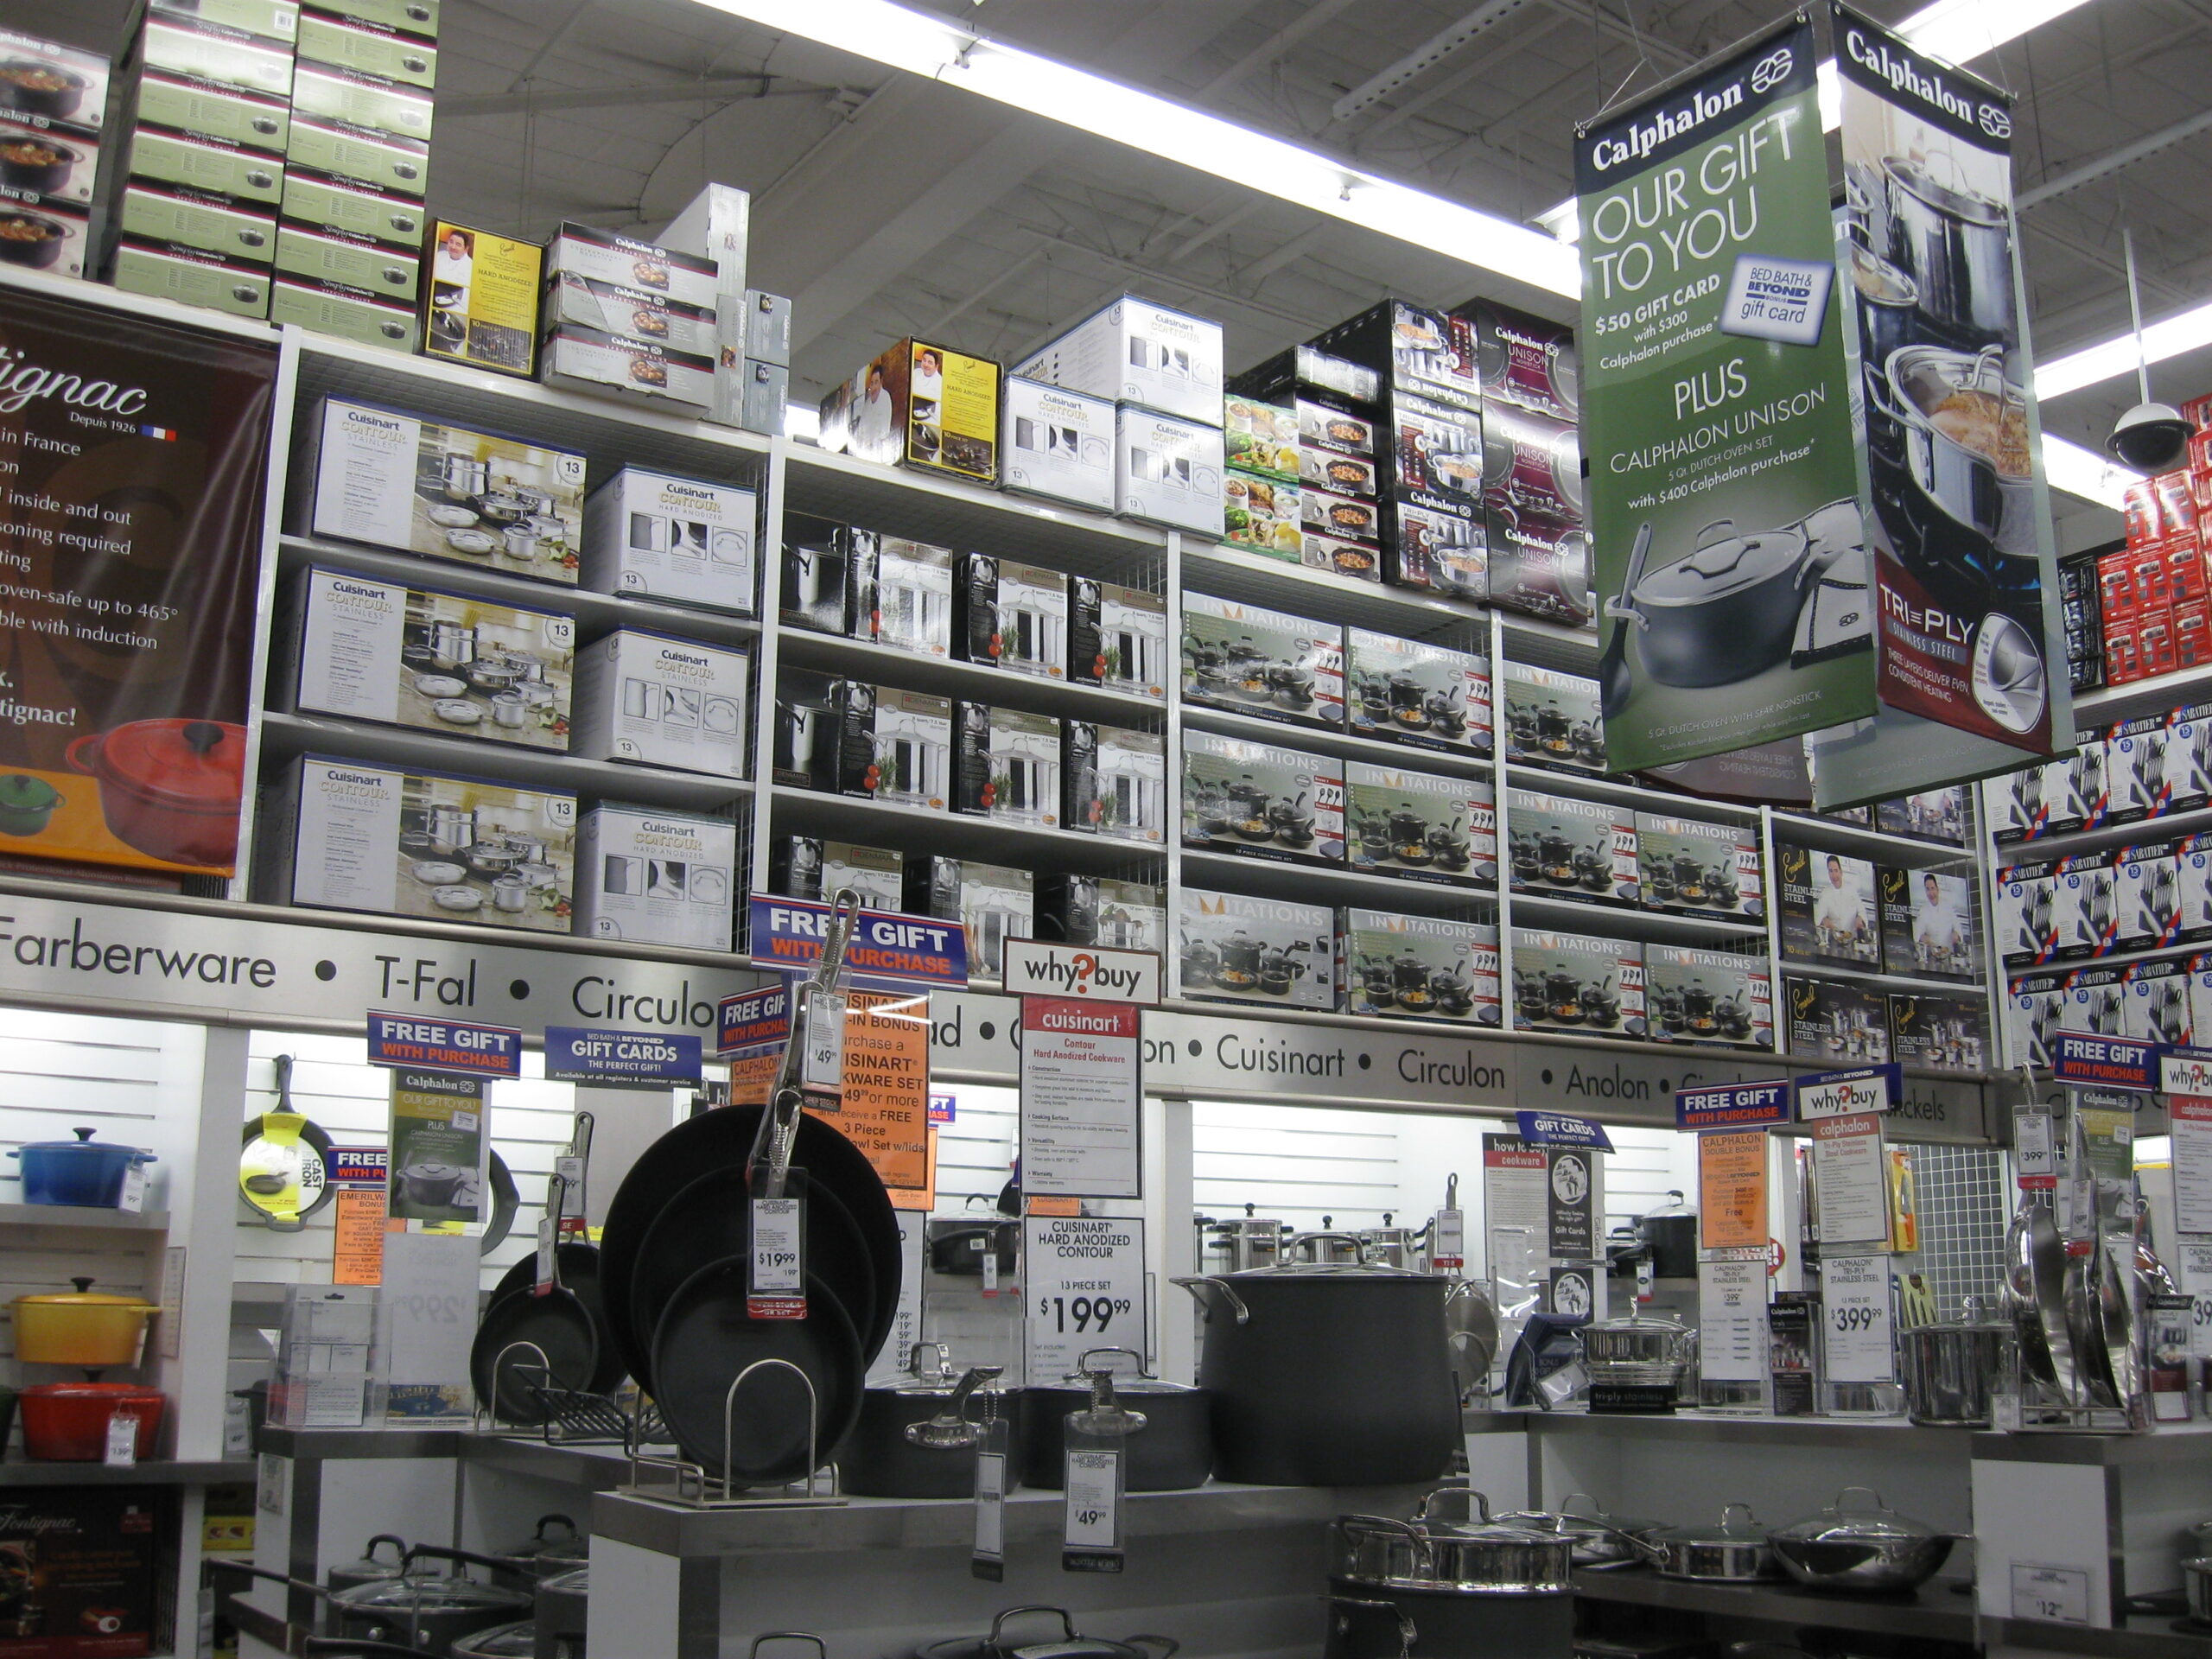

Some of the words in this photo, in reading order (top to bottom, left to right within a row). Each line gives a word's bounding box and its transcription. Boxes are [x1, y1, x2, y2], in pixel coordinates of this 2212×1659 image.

[1847, 31, 1974, 124] Calphalon
[1592, 84, 1742, 171] Calphalon
[1593, 168, 1689, 244] OUR
[1699, 109, 1797, 194] GIFT
[1593, 242, 1653, 299] TO
[1661, 186, 1758, 271] YOU
[1748, 281, 1810, 297] BEYOND
[1595, 307, 1630, 337] $50
[1635, 296, 1670, 324] GIFT
[1674, 274, 1720, 308] CARD
[1741, 300, 1764, 320] gift
[1769, 307, 1806, 323] card
[1496, 327, 1544, 350] Calphalon
[1634, 324, 1656, 344] with
[1659, 311, 1688, 334] $300
[1508, 346, 1549, 366] UNISON
[1599, 345, 1659, 371] Calphalon
[1674, 358, 1747, 421] PLUS
[1043, 393, 1082, 410] Cuisinart
[70, 412, 108, 429] Depuis
[111, 420, 137, 434] 1926
[347, 411, 400, 431] Cuisinart
[1610, 419, 1729, 474] CALPHALON
[1735, 382, 1825, 435] UNISON
[2, 428, 17, 444] in
[24, 432, 81, 455] France
[1690, 451, 1721, 474] DUTCH
[1723, 442, 1752, 460] OVEN
[1755, 435, 1773, 449] SET
[565, 461, 580, 474] 13
[666, 483, 715, 499] Cuisinart
[1628, 493, 1656, 510] with
[1659, 484, 1688, 505] $400
[1690, 465, 1747, 493] Calphalon
[9, 489, 60, 512] inside
[66, 504, 99, 518] and
[104, 511, 131, 525] out
[1410, 492, 1457, 513] Calphalon
[59, 531, 132, 555] required
[0, 583, 82, 607] oven-safe
[88, 599, 110, 615] up
[116, 601, 132, 614] to
[333, 581, 385, 601] Cuisinart
[31, 618, 69, 636] with
[76, 623, 158, 650] induction
[1931, 641, 1955, 660] STEEL
[2122, 717, 2156, 734] SABATIER
[1365, 769, 1472, 798] INVITATIONS
[641, 821, 695, 836] Cuisinart
[2131, 845, 2164, 861] SABATIER
[872, 921, 949, 951] GIFT
[1370, 914, 1476, 939] INVITATIONS
[772, 938, 823, 959] WITH
[844, 948, 951, 976] PURCHASE
[374, 954, 476, 1007] T-Fal
[572, 975, 715, 1028] Circulo
[1042, 1008, 1119, 1033] cuisinart
[381, 1020, 447, 1045] FREE
[454, 1029, 510, 1052] GIFT
[1065, 1038, 1096, 1050] Contour
[382, 1043, 423, 1059] WITH
[428, 1048, 510, 1069] PURCHASE
[571, 1040, 613, 1058] GIFT
[617, 1043, 678, 1063] CARDS
[1033, 1049, 1052, 1058] Hard
[1053, 1051, 1087, 1061] Anodized
[1089, 1052, 1126, 1064] Cookware
[1217, 1034, 1345, 1077] Cuisinart
[2064, 1039, 2106, 1060] FREE
[2109, 1045, 2146, 1065] GIFT
[1398, 1049, 1505, 1090] Circulon
[2064, 1061, 2090, 1075] WITH
[2093, 1065, 2145, 1081] PURCHASE
[406, 1075, 458, 1090] Calphalon
[1566, 1065, 1649, 1100] Anolon
[880, 1110, 912, 1122] FREE
[855, 1123, 886, 1136] Piece
[1702, 1134, 1761, 1147] CALPHALON
[1820, 1121, 1871, 1138] calphalon
[873, 1140, 890, 1150] Set
[1502, 1155, 1540, 1166] cookware
[312, 1159, 321, 1191] CAST
[1052, 1221, 1109, 1234] CUISINART
[1039, 1234, 1071, 1245] HARD
[1073, 1234, 1131, 1246] ANODIZED
[1058, 1246, 1114, 1258] CONTOUR
[1060, 1281, 1071, 1290] 13
[1072, 1281, 1096, 1290] PIECE
[1098, 1281, 1111, 1290] SET
